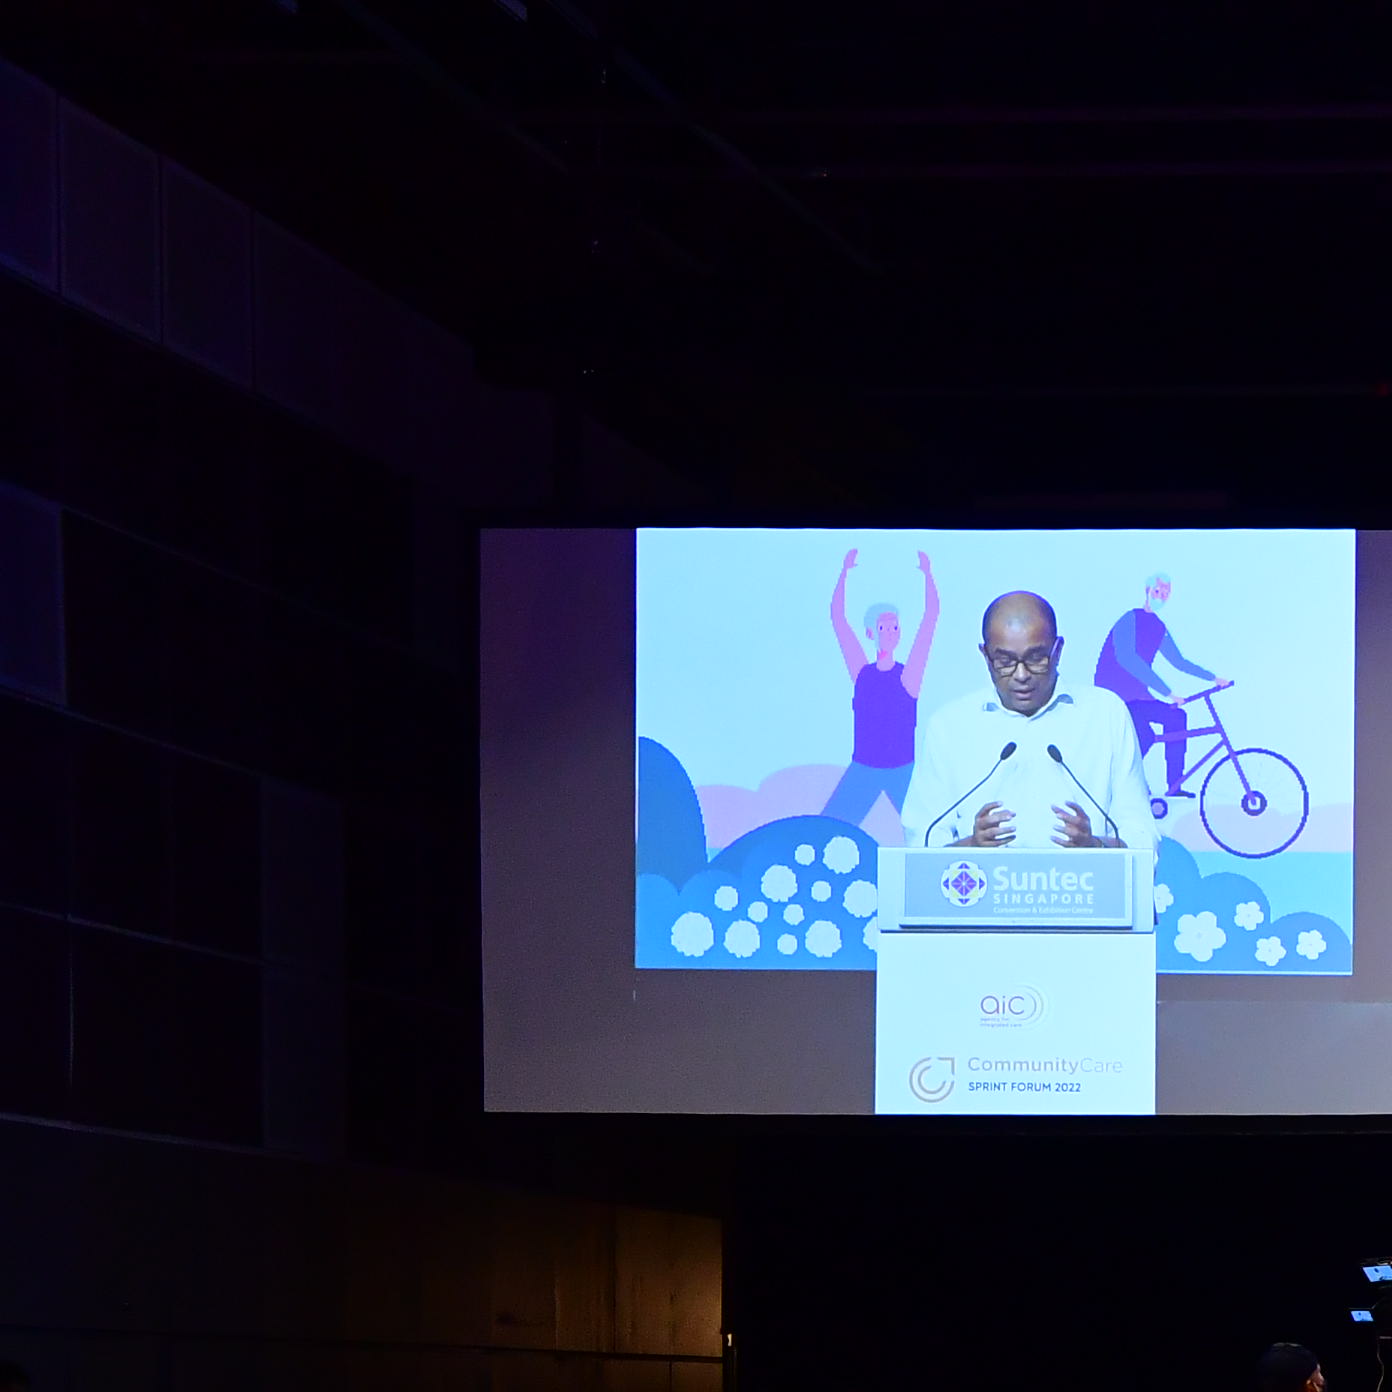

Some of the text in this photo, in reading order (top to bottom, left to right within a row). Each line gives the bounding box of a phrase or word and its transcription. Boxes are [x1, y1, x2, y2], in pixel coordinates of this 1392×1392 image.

[992, 866, 1094, 891] Suntec
[993, 893, 1094, 905] SINGAPORE
[980, 995, 1025, 1015] aic
[967, 1056, 1123, 1075] CommunityCare
[968, 1082, 1081, 1093] SPRINT FORUM 2022
